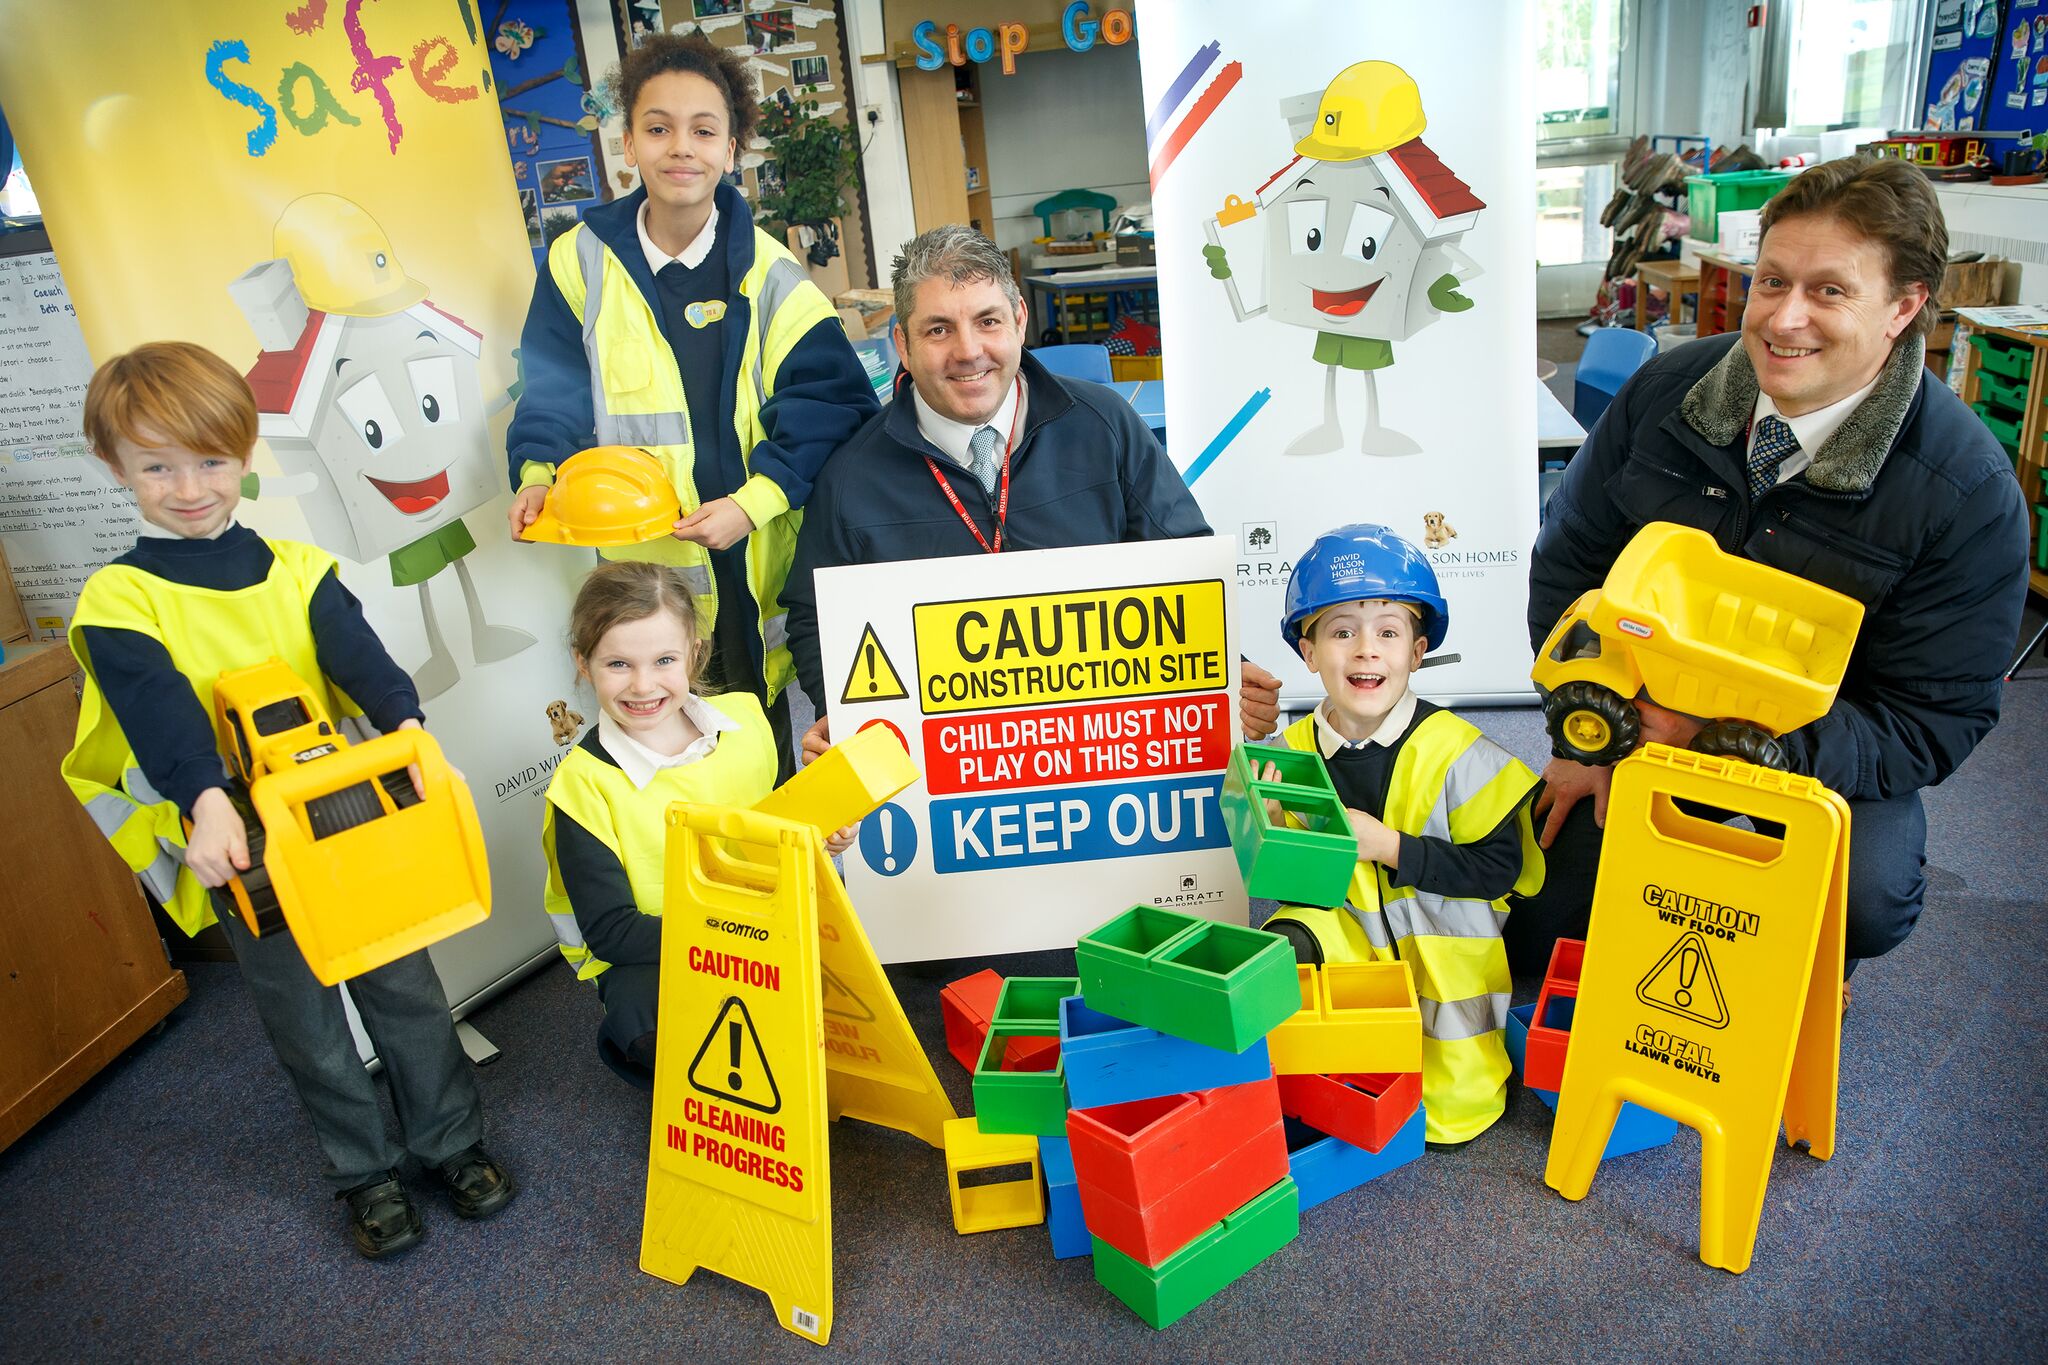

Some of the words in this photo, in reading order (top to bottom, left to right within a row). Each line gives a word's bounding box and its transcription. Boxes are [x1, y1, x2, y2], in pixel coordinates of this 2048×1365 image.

[912, 18, 1030, 76] Siop
[27, 356, 48, 364] choose
[941, 481, 959, 505] VISITOR
[999, 488, 1007, 513] VISITOR
[961, 512, 978, 535] VISITOR
[1330, 560, 1365, 571] WILSON
[1333, 553, 1360, 564] DAVID
[1466, 550, 1518, 563] HOMES
[1332, 567, 1364, 579] HOMES
[1462, 570, 1485, 578] LIVES
[956, 594, 1187, 663] CAUTION
[928, 657, 1152, 703] CONSTRUCTION
[1160, 650, 1220, 683] SITE
[939, 716, 1076, 753] CHILDREN
[1083, 708, 1157, 742] MUST
[1164, 703, 1219, 734] NOT
[301, 744, 330, 761] CAT
[959, 753, 1025, 785] PLAY
[1034, 748, 1073, 779] ON
[1081, 742, 1140, 774] THIS
[1148, 736, 1203, 768] SITE
[495, 766, 538, 798] DAVID
[952, 798, 1092, 861] KEEP
[1107, 787, 1215, 847] OUT
[1154, 890, 1224, 905] BARRATT
[1175, 900, 1204, 908] HOMES
[1643, 884, 1760, 936] CAUTION
[721, 920, 769, 942] CONTICO
[1658, 909, 1686, 927] WET
[1689, 919, 1736, 942] FLOOR
[688, 945, 780, 992] CAUTION
[1624, 1039, 1670, 1065] LLAWR
[1673, 1058, 1721, 1083] GWLYB
[1635, 1023, 1714, 1069] GOFAL
[683, 1097, 786, 1153] CLEANING
[667, 1123, 687, 1153] IN
[693, 1132, 804, 1193] PROGRESS
